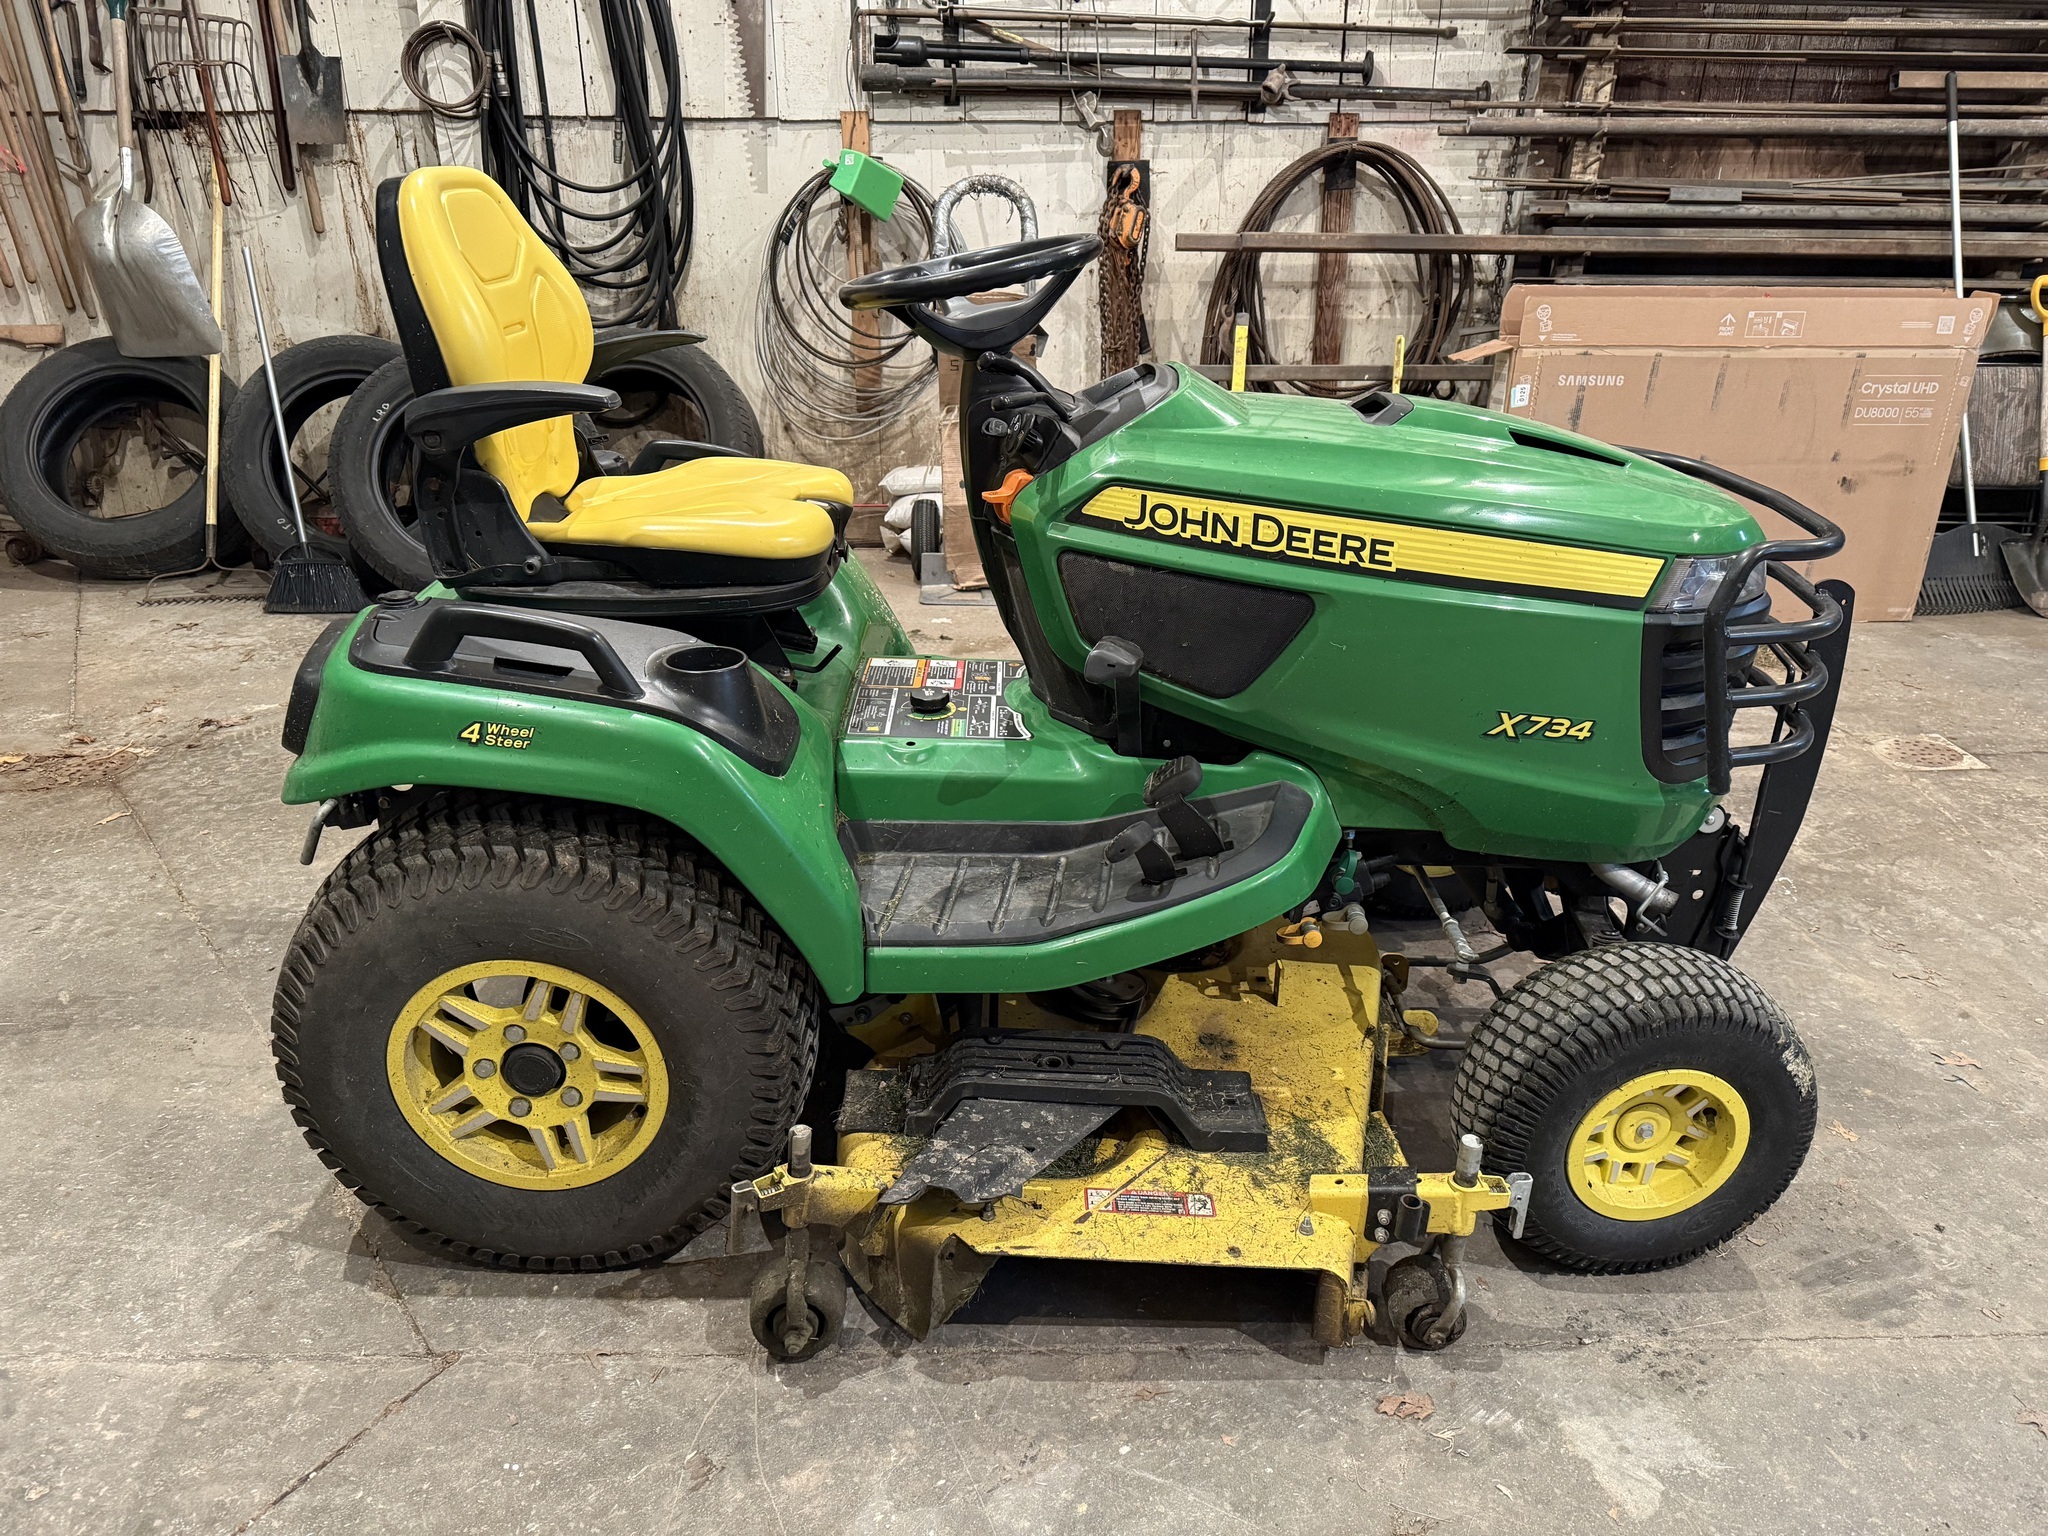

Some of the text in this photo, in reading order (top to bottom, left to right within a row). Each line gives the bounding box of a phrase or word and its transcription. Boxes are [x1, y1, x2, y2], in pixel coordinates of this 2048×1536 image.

[1558, 375, 1625, 387] SAMSUNG
[1861, 382, 1939, 398] Crystal UHD
[1855, 407, 1899, 418] DU8000
[1124, 494, 1397, 569] JOHN DEERE
[459, 721, 535, 744] 4 Wheel
[1484, 712, 1594, 741] X734
[484, 734, 530, 749] Steer
